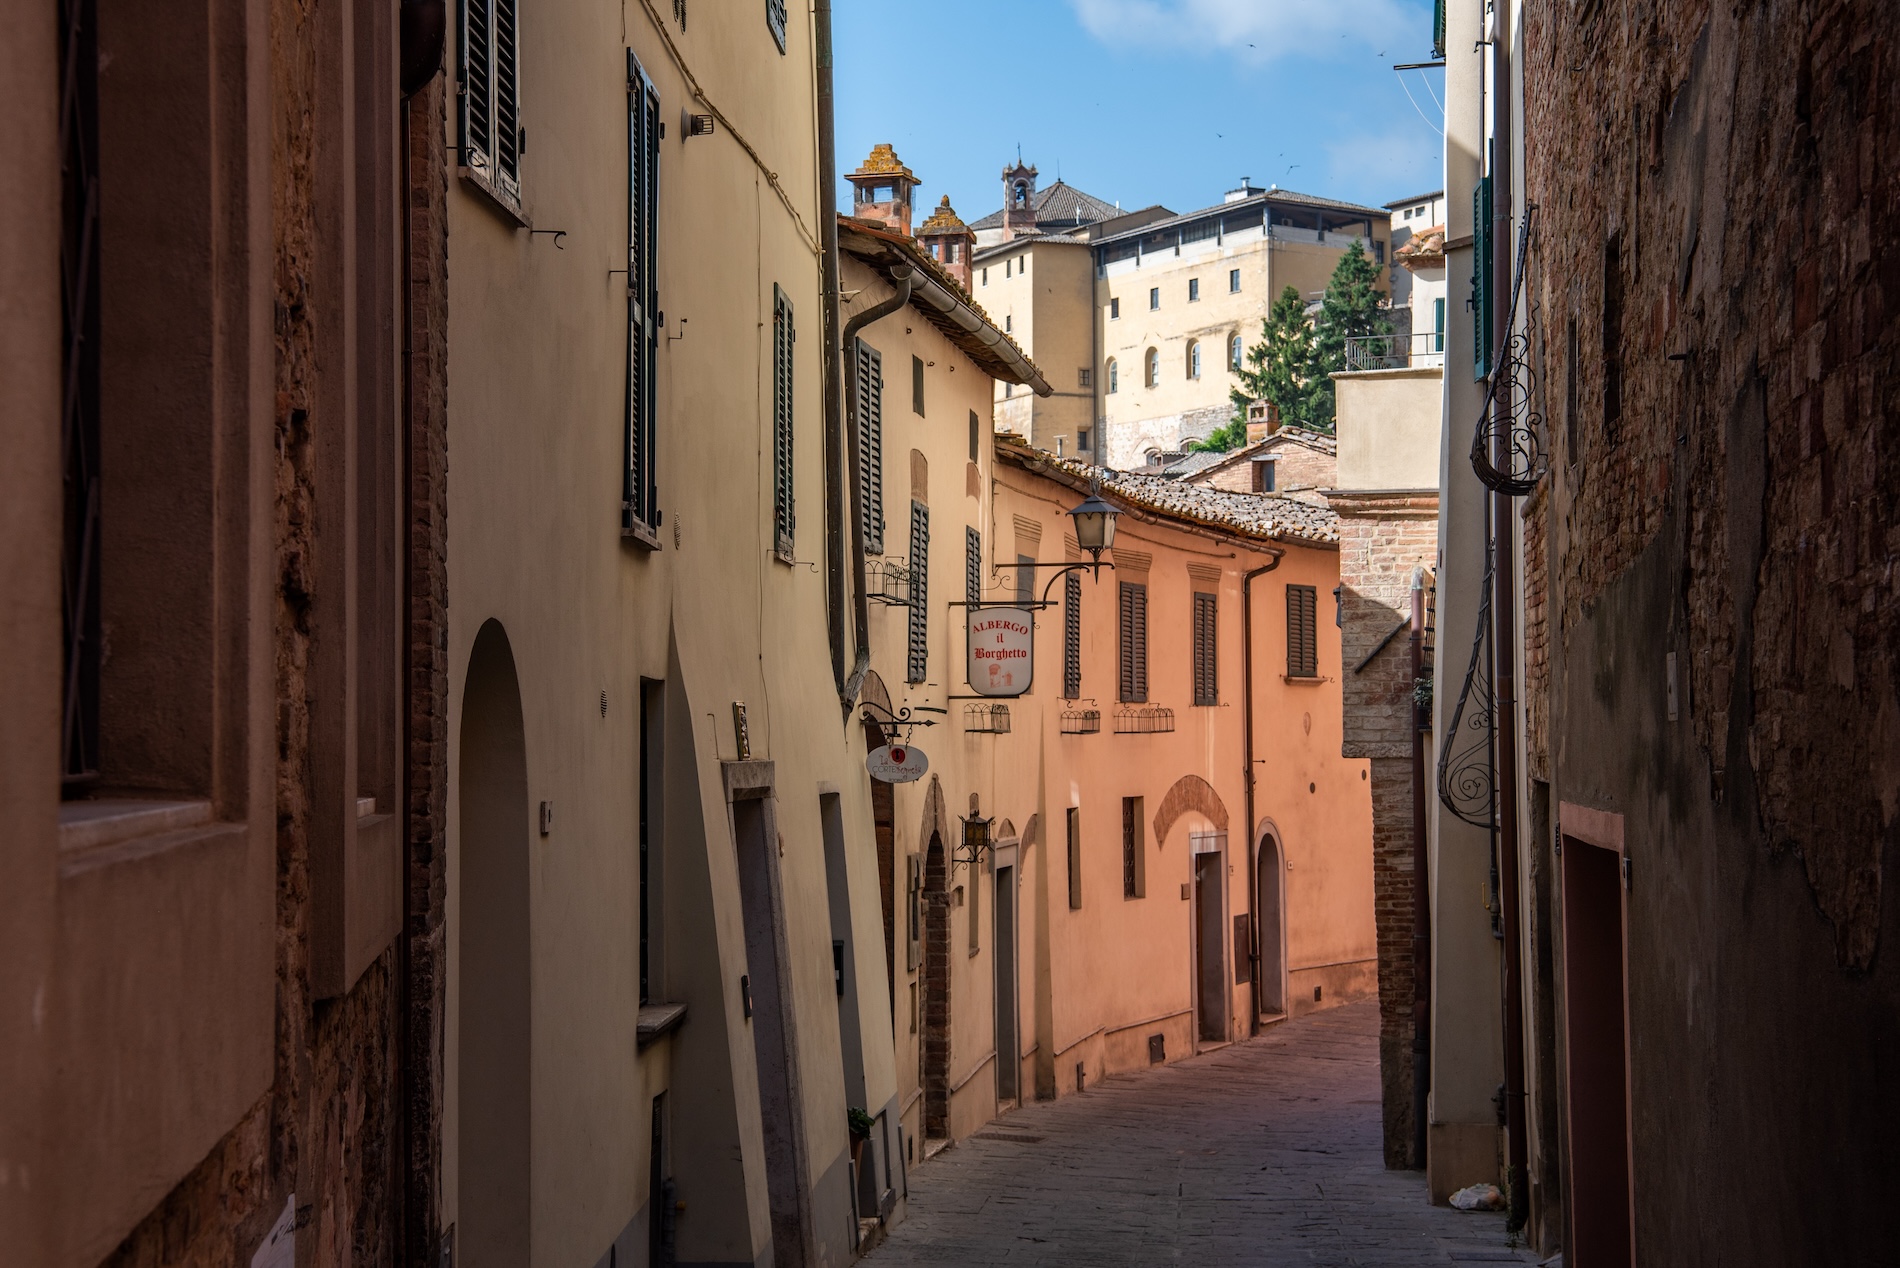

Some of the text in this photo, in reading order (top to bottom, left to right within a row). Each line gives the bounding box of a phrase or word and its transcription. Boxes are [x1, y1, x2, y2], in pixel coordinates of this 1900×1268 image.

[973, 620, 1029, 635] ALBERGO
[996, 632, 1004, 643] il
[974, 648, 1027, 660] Borghetto
